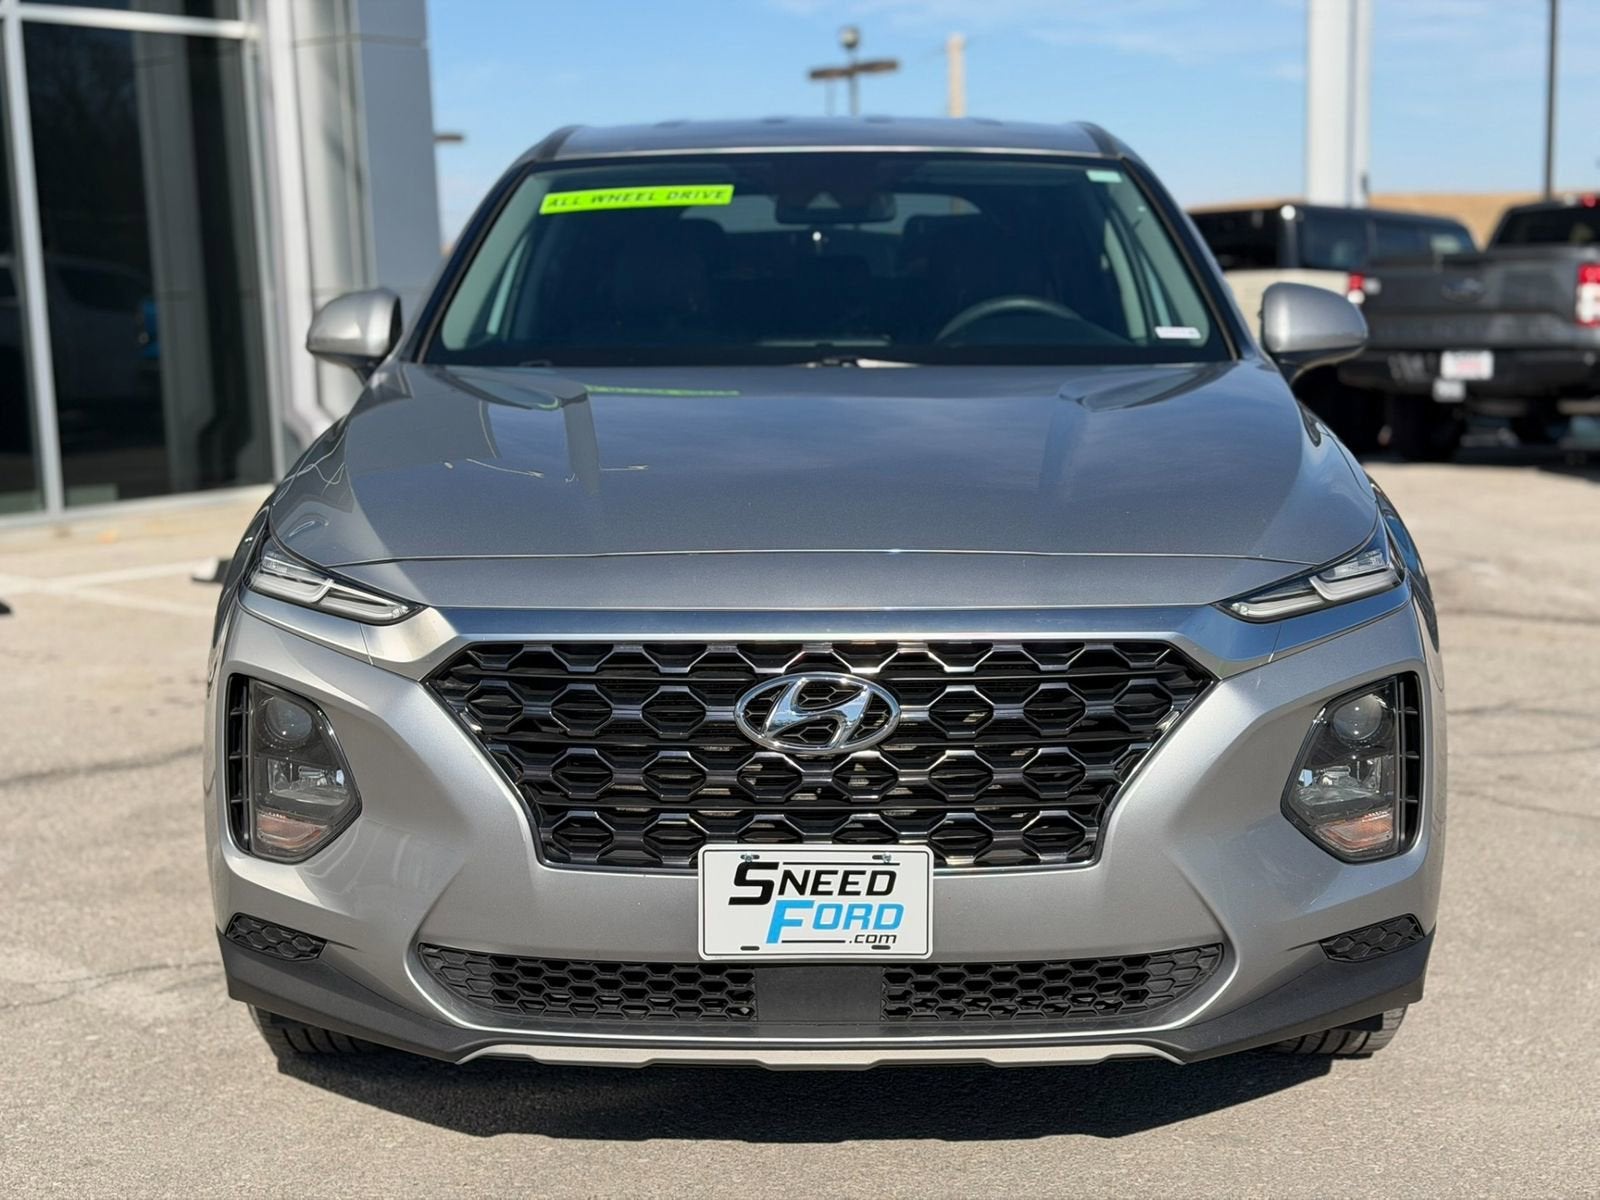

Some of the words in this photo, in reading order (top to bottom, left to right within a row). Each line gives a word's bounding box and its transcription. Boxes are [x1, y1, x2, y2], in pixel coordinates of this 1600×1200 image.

[548, 195, 580, 208] ALL
[592, 192, 656, 204] WHEEL
[666, 189, 726, 201] DRIVE
[728, 861, 897, 905] SNEED
[765, 900, 905, 944] FORD
[849, 934, 897, 944] .com
